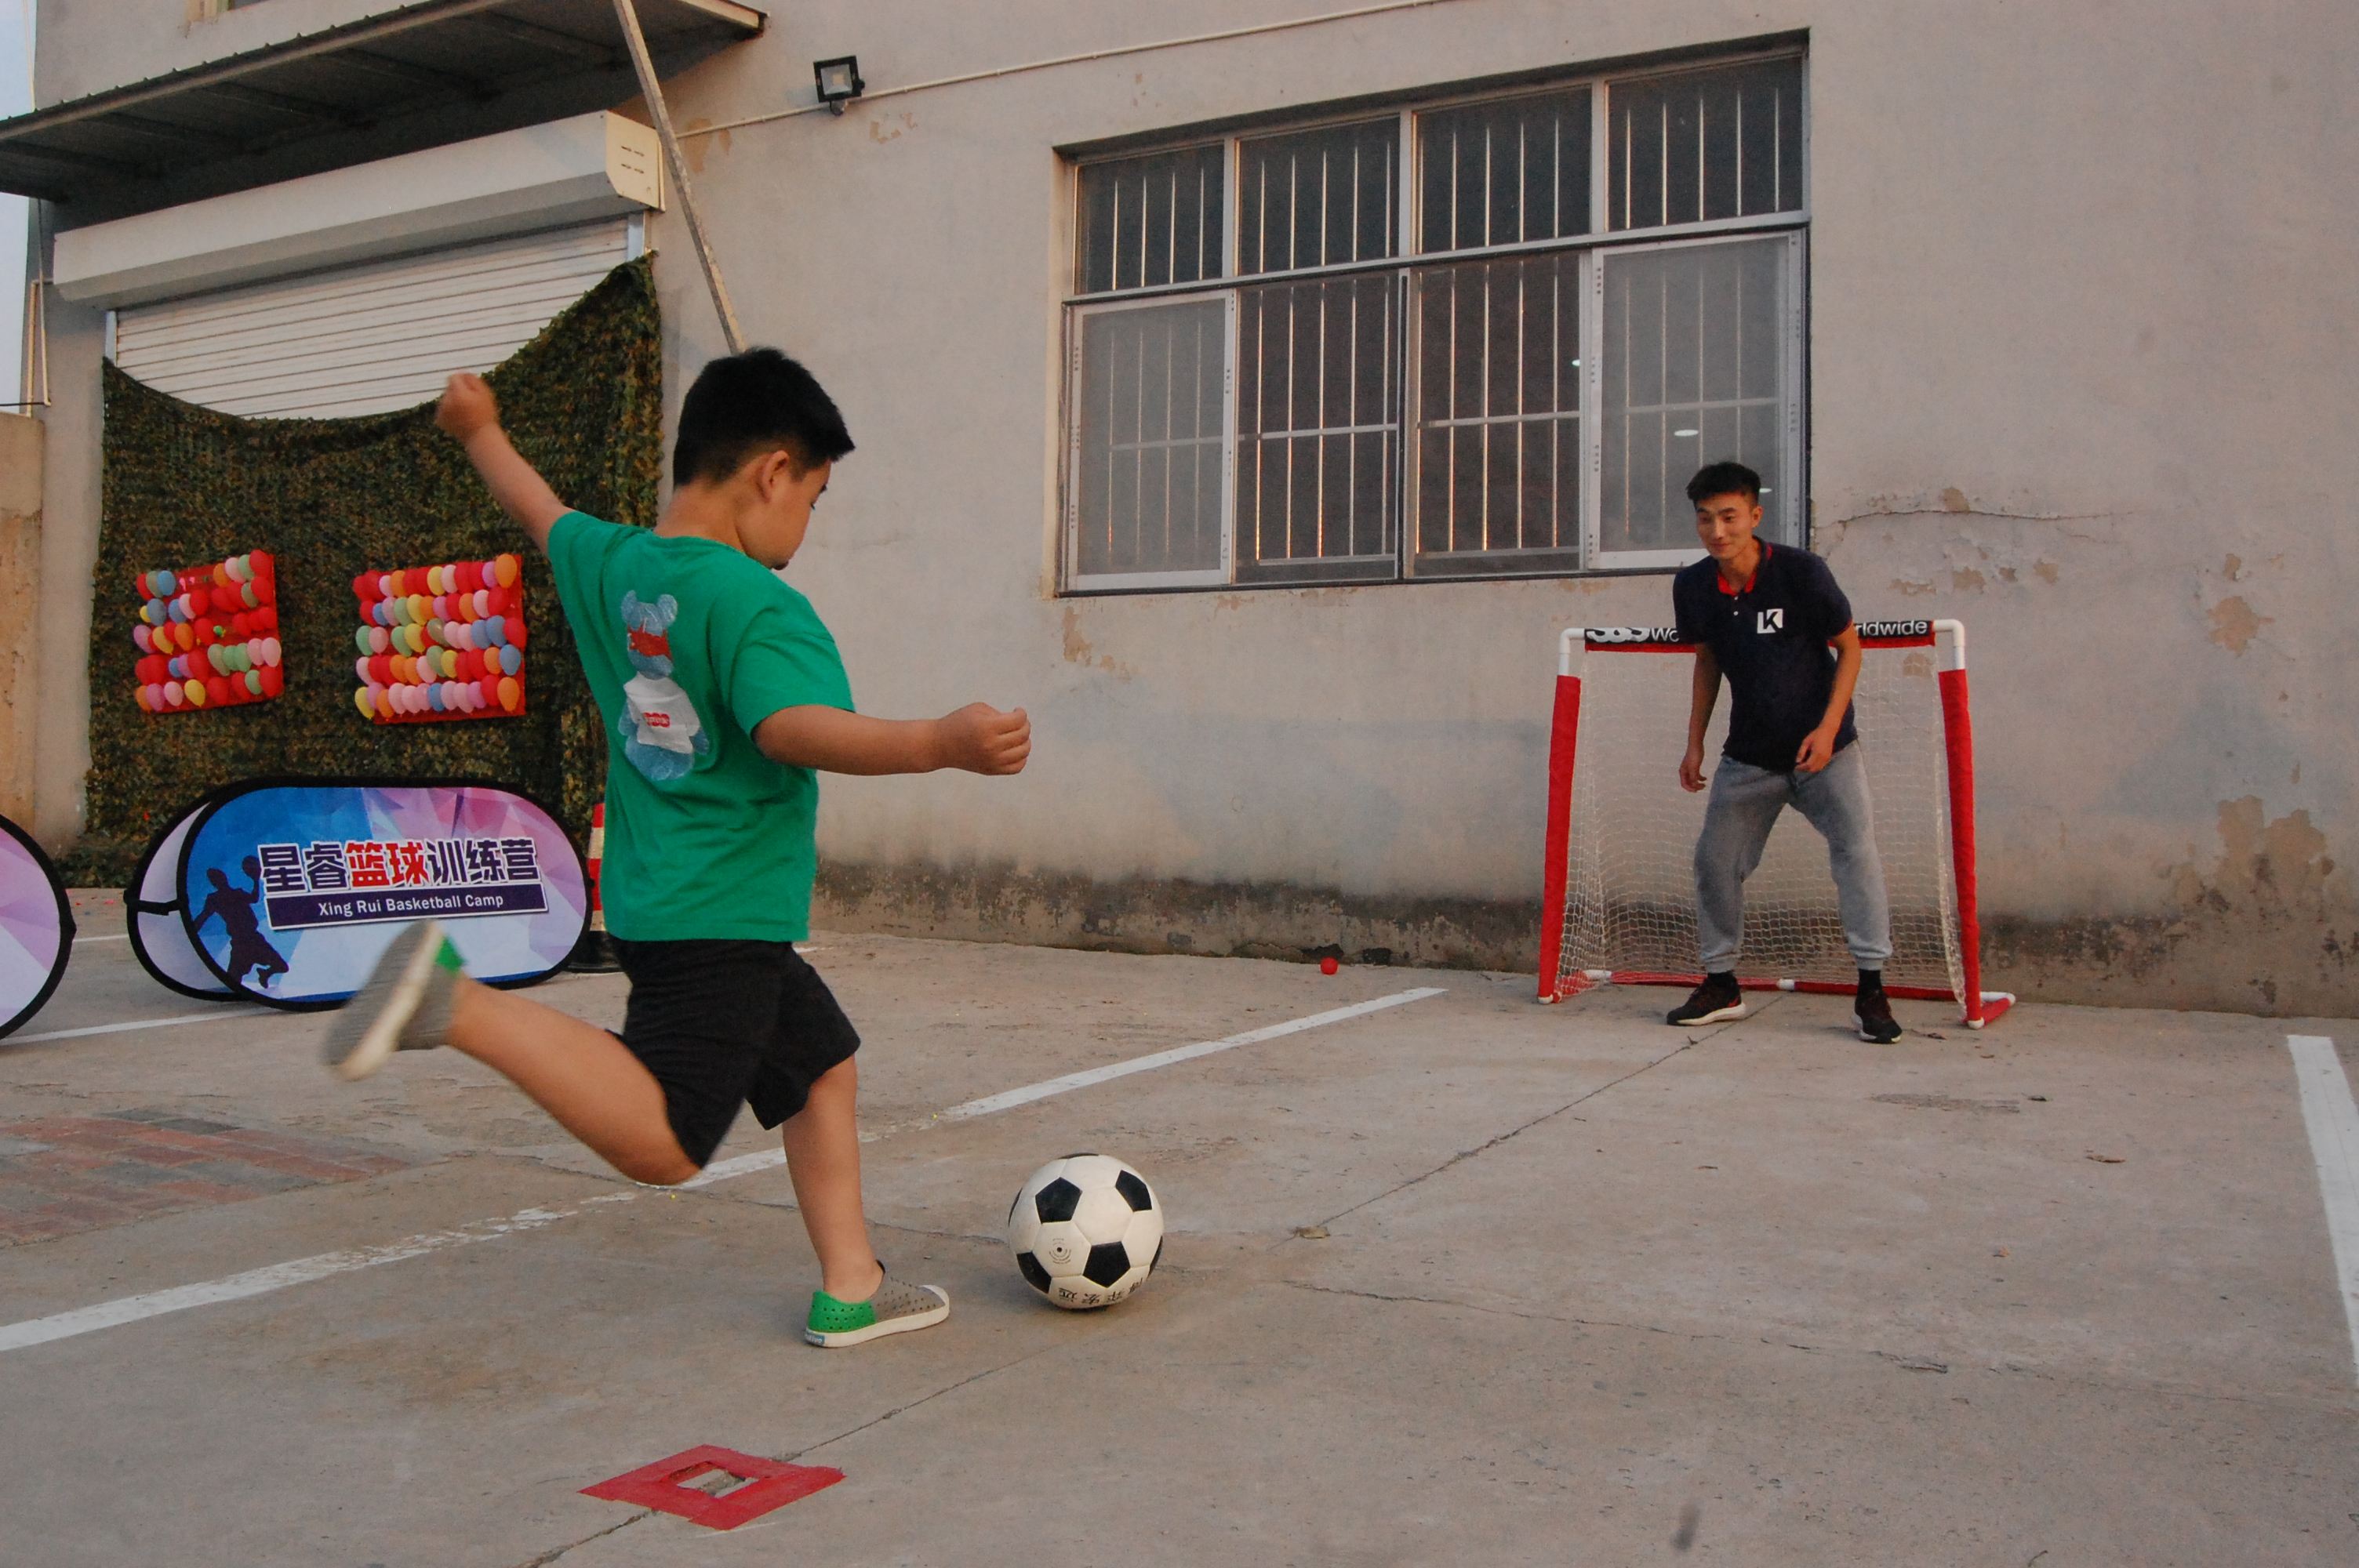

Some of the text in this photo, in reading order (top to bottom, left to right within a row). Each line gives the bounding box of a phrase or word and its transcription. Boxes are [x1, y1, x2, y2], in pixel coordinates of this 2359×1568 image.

[1856, 620, 1928, 637] rldwide
[259, 838, 541, 894] 星睿篮球训练营
[318, 895, 503, 917] Xing Rui Basketball Camp
